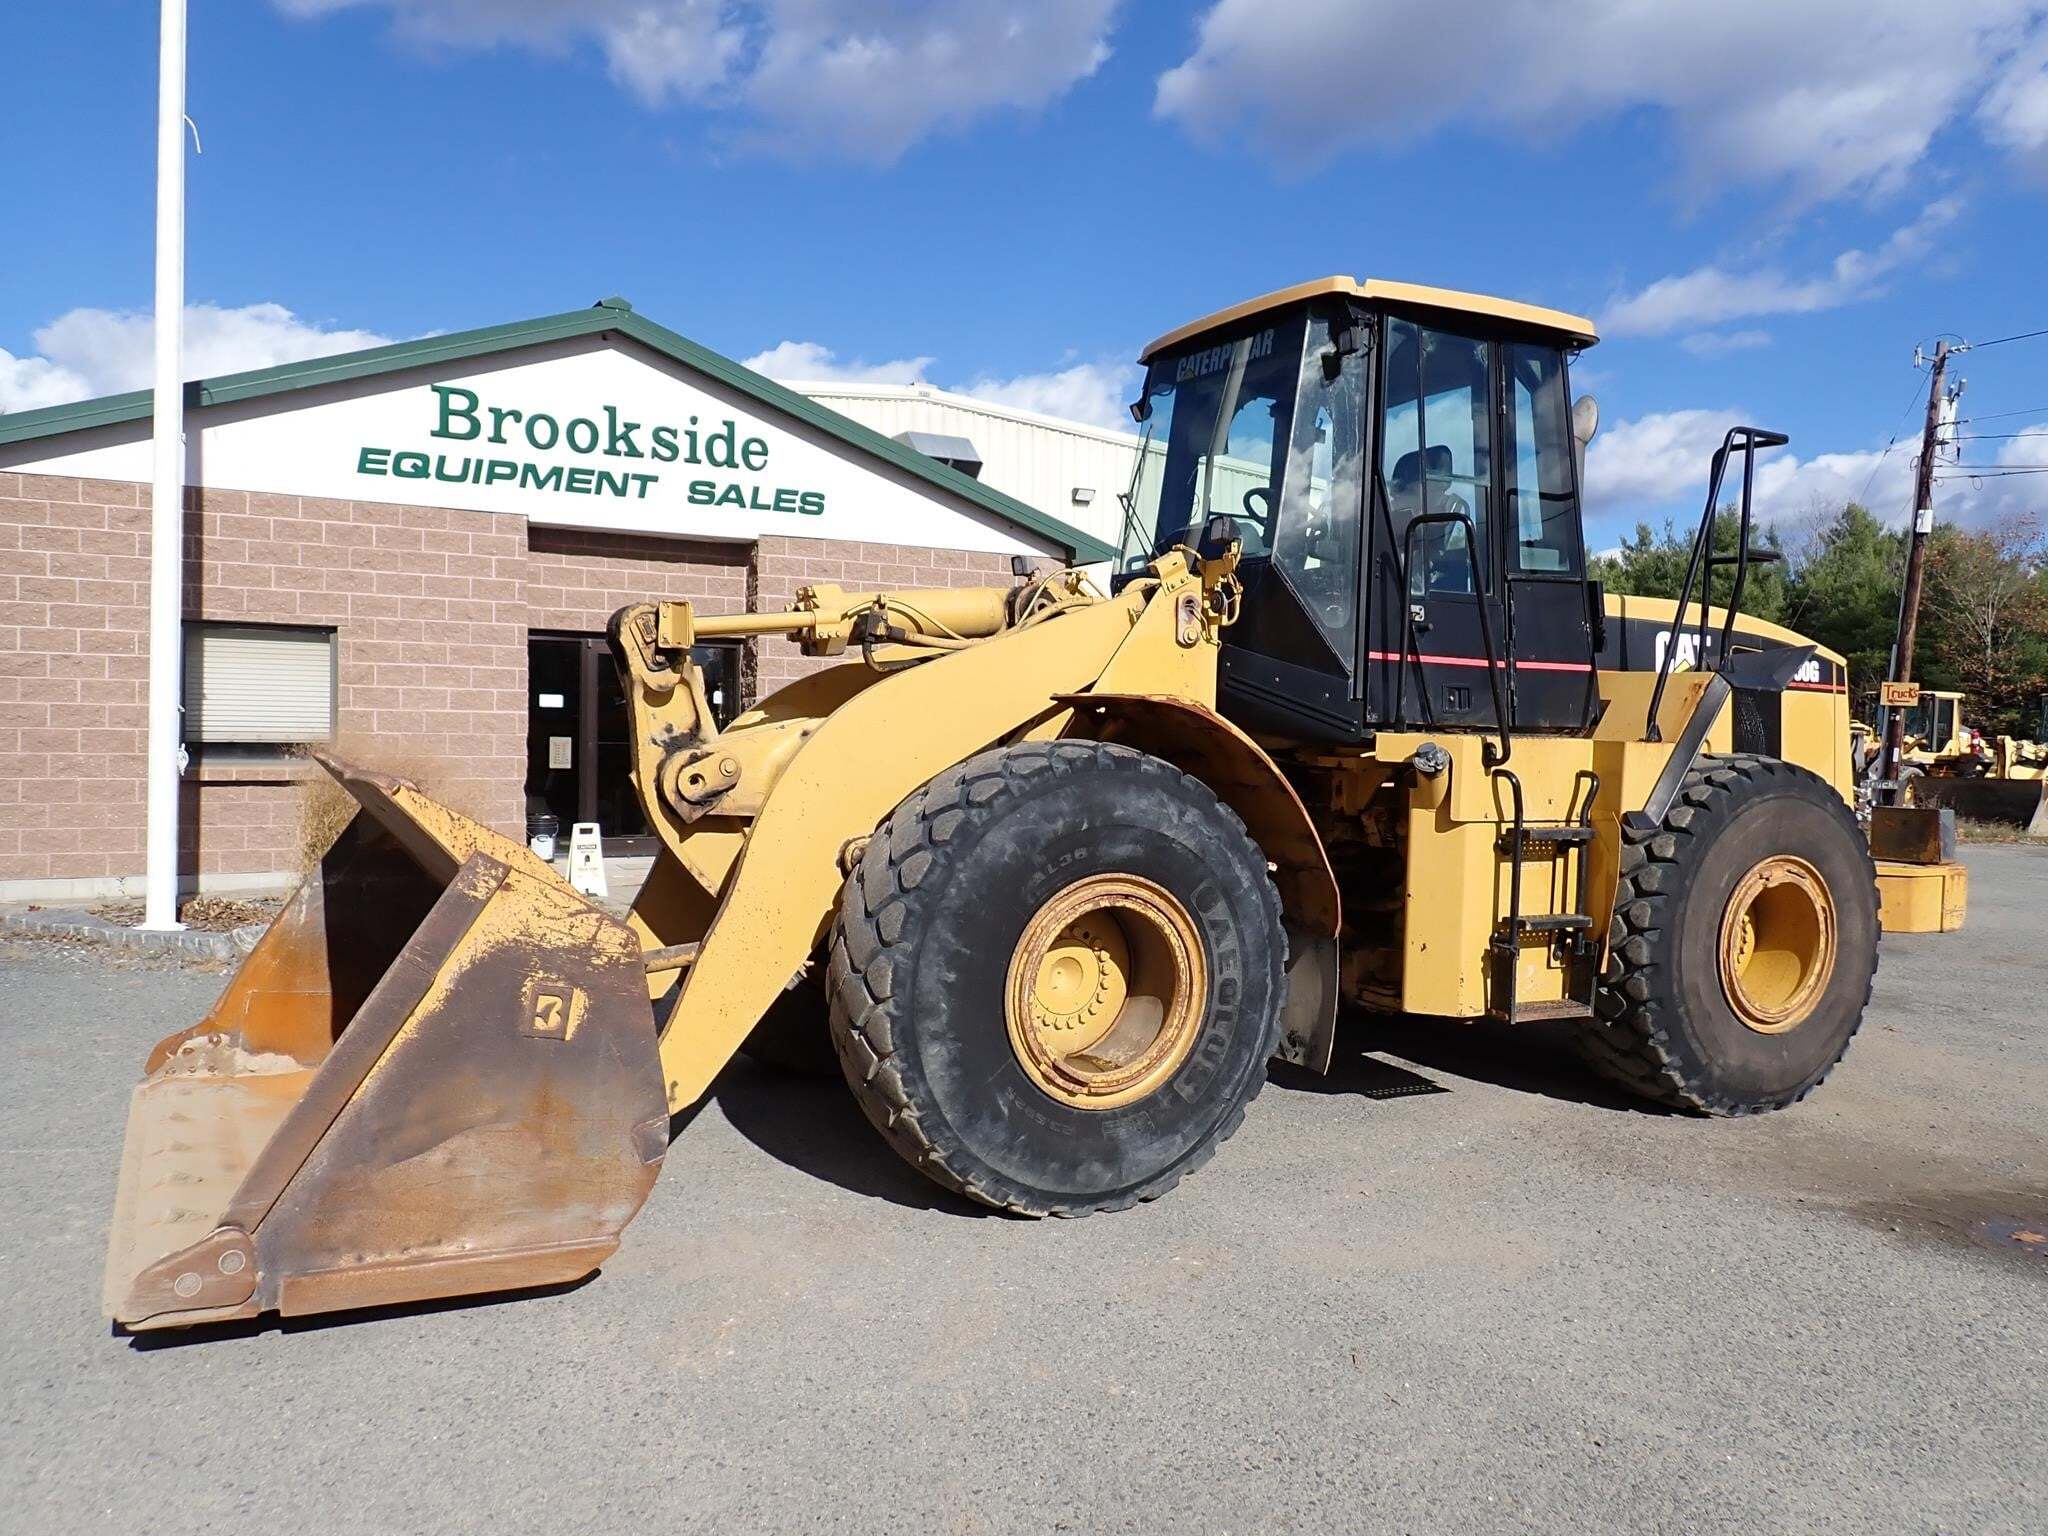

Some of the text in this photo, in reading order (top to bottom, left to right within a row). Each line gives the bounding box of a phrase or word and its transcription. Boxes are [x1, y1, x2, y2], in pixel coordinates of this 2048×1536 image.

[1176, 328, 1274, 382] CATERPAR
[430, 384, 769, 471] Brookside
[357, 447, 825, 515] EQUIPMENT SALES
